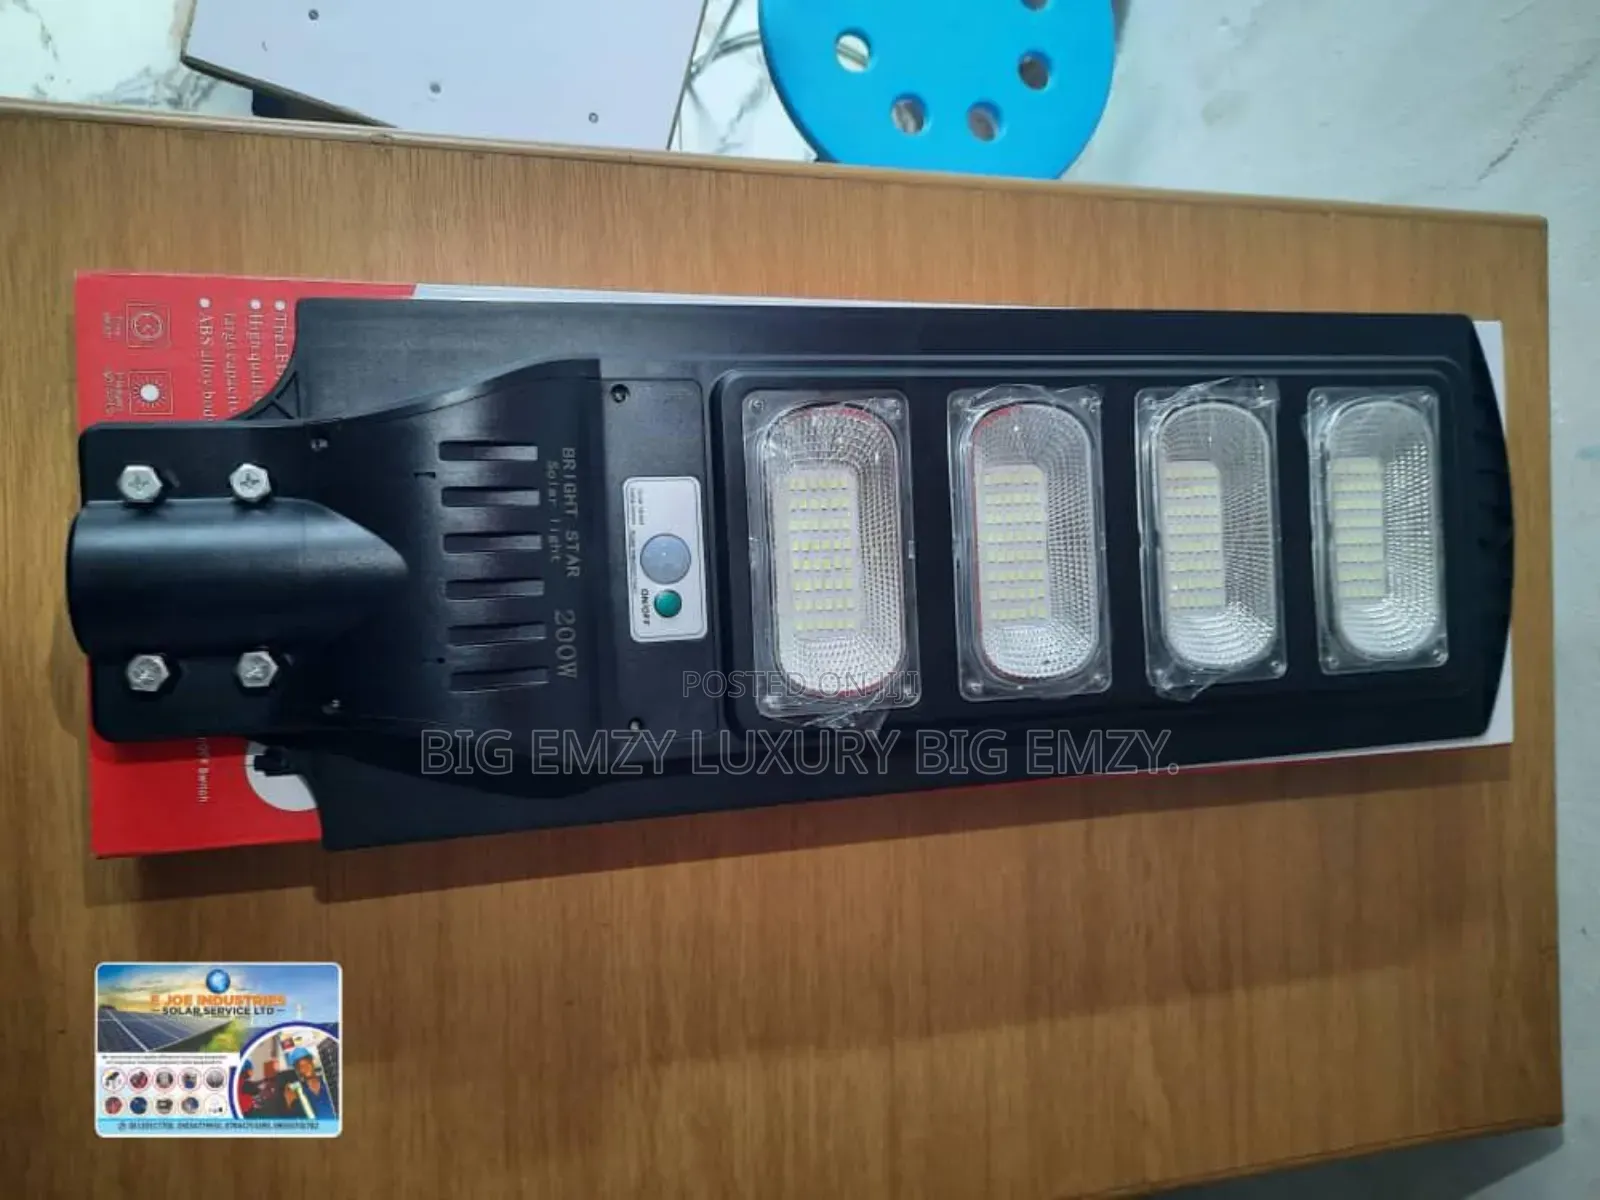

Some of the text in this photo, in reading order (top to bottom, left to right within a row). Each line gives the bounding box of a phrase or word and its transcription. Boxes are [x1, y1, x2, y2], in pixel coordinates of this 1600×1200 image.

[199, 313, 215, 345] ABS
[204, 390, 218, 422] bod
[547, 460, 561, 504] Solar
[562, 447, 580, 578] BRIGHT STAR
[641, 588, 650, 626] ON/OFF
[554, 609, 578, 679] 200W
